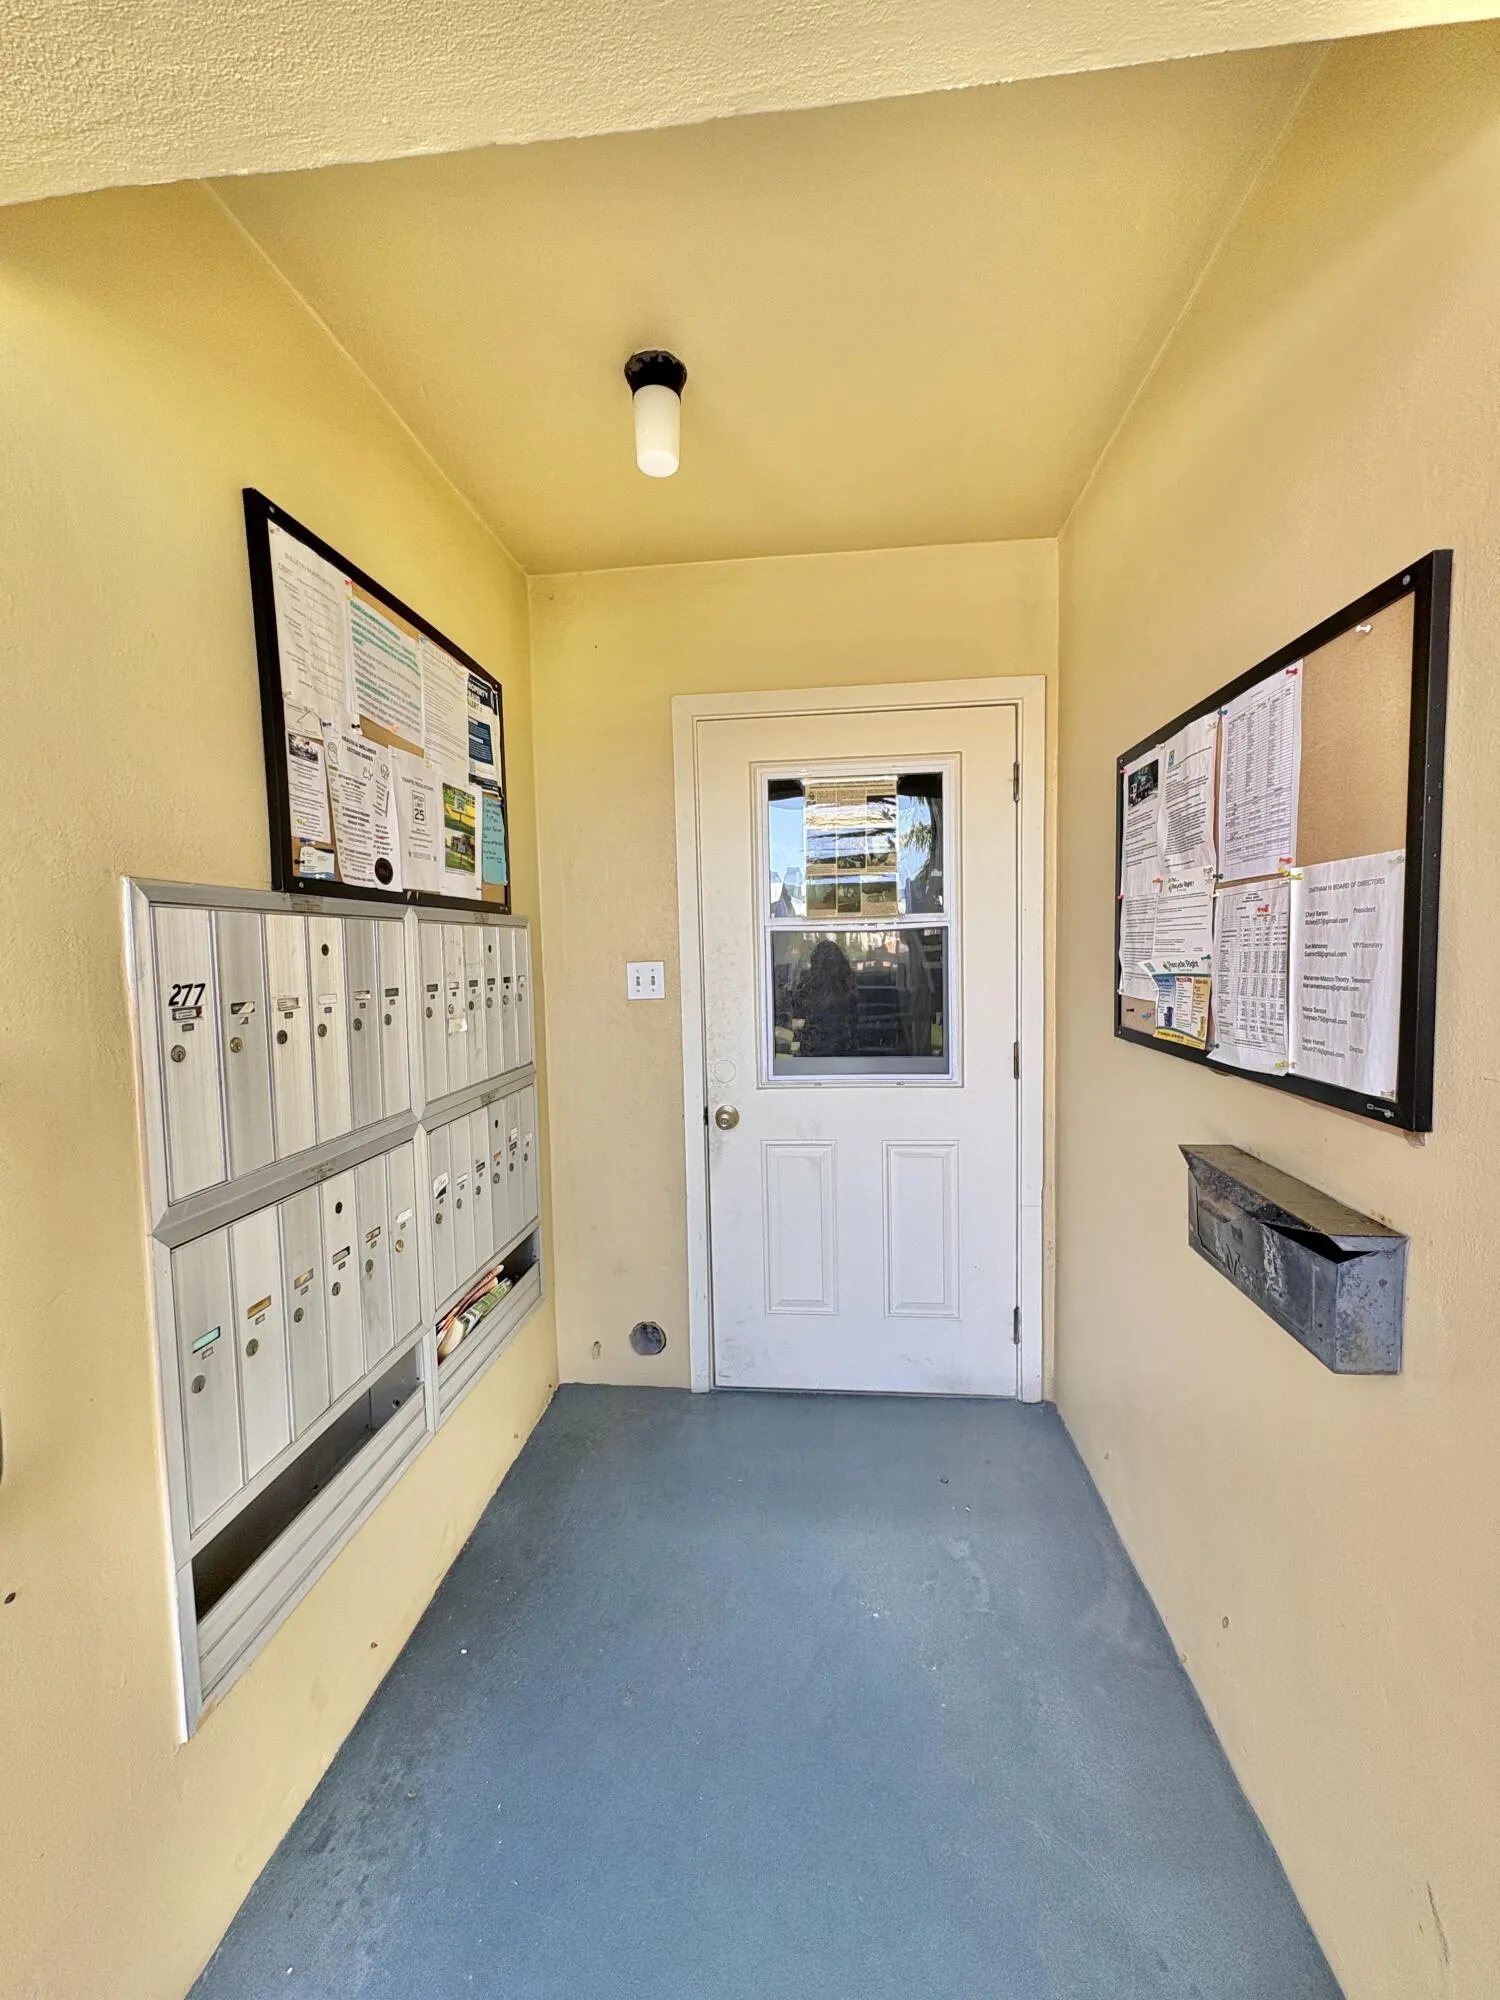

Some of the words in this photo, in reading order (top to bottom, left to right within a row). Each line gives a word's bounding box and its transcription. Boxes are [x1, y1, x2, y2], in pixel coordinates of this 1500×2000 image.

[414, 808, 424, 822] 25
[1333, 882, 1350, 890] BOARD
[1350, 880, 1357, 888] OF
[1356, 878, 1386, 887] DIRECTORS
[168, 983, 206, 1007] 277
